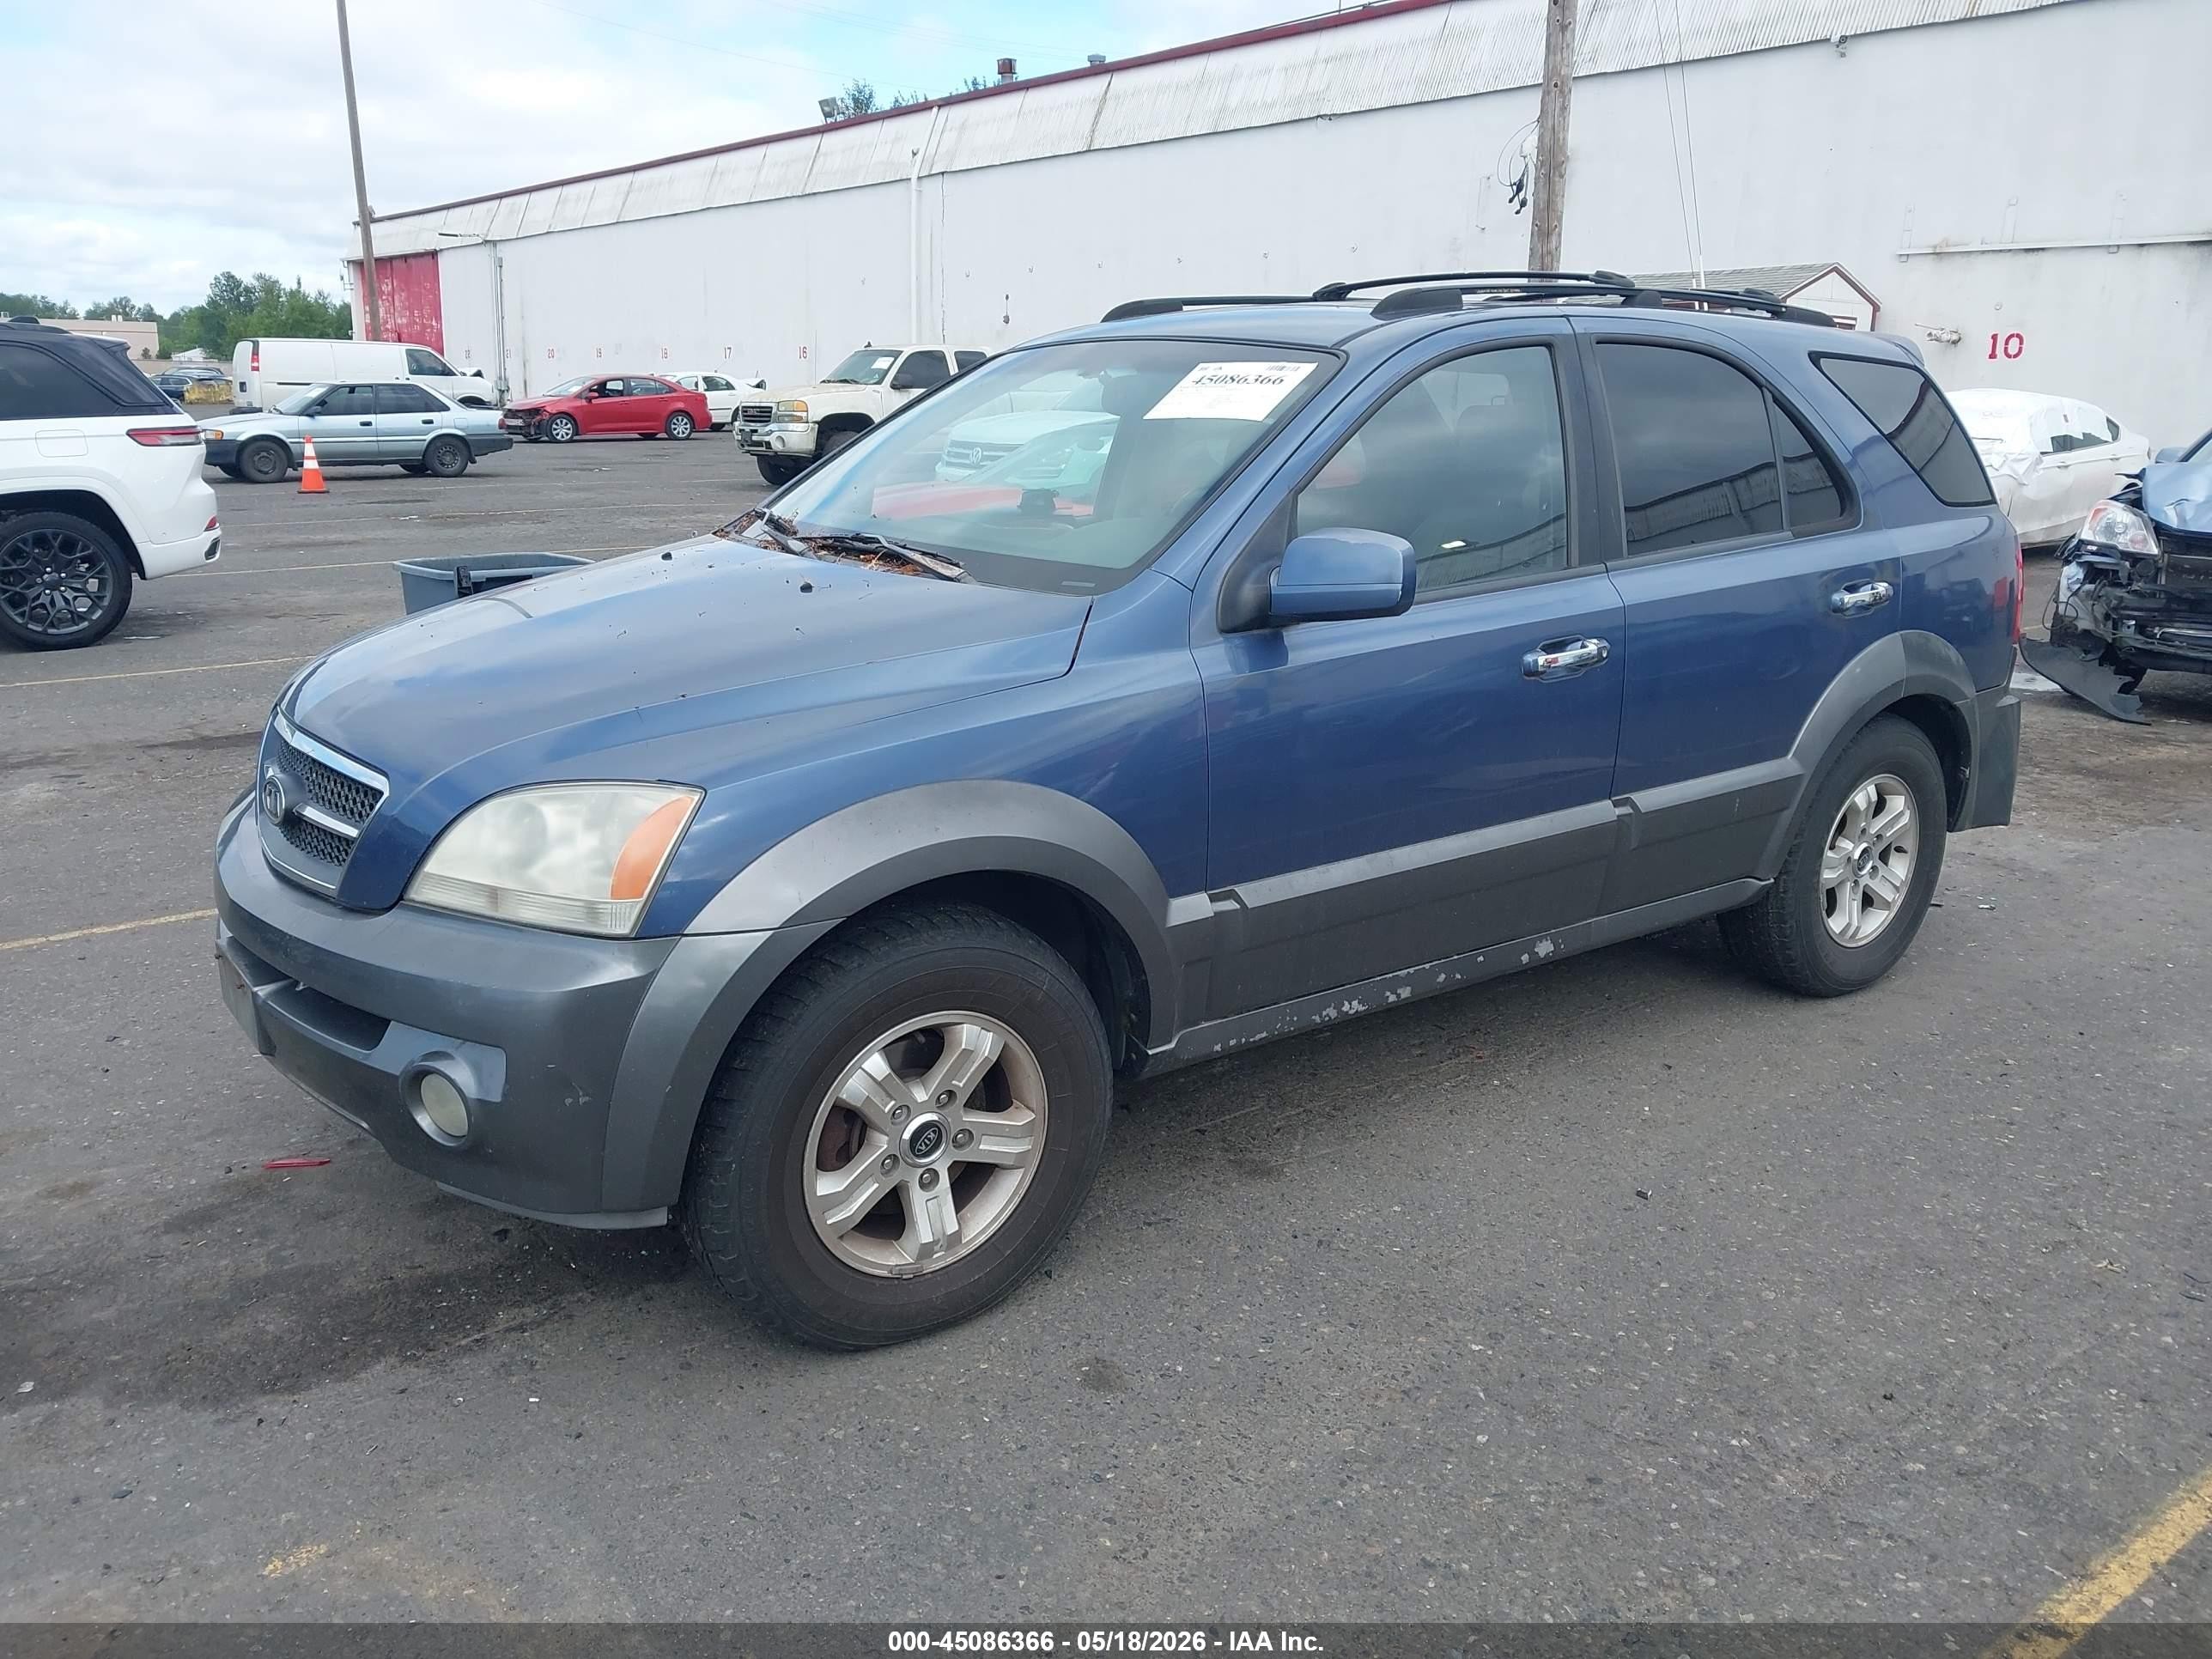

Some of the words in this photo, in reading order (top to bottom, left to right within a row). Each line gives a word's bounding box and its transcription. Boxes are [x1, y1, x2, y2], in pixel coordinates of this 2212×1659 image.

[724, 346, 732, 360] 17
[799, 345, 808, 360] 16
[1988, 332, 2025, 360] 10
[547, 348, 555, 359] 20
[660, 347, 669, 360] 18
[1191, 374, 1286, 385] 45086366
[918, 1132, 936, 1151] KIA
